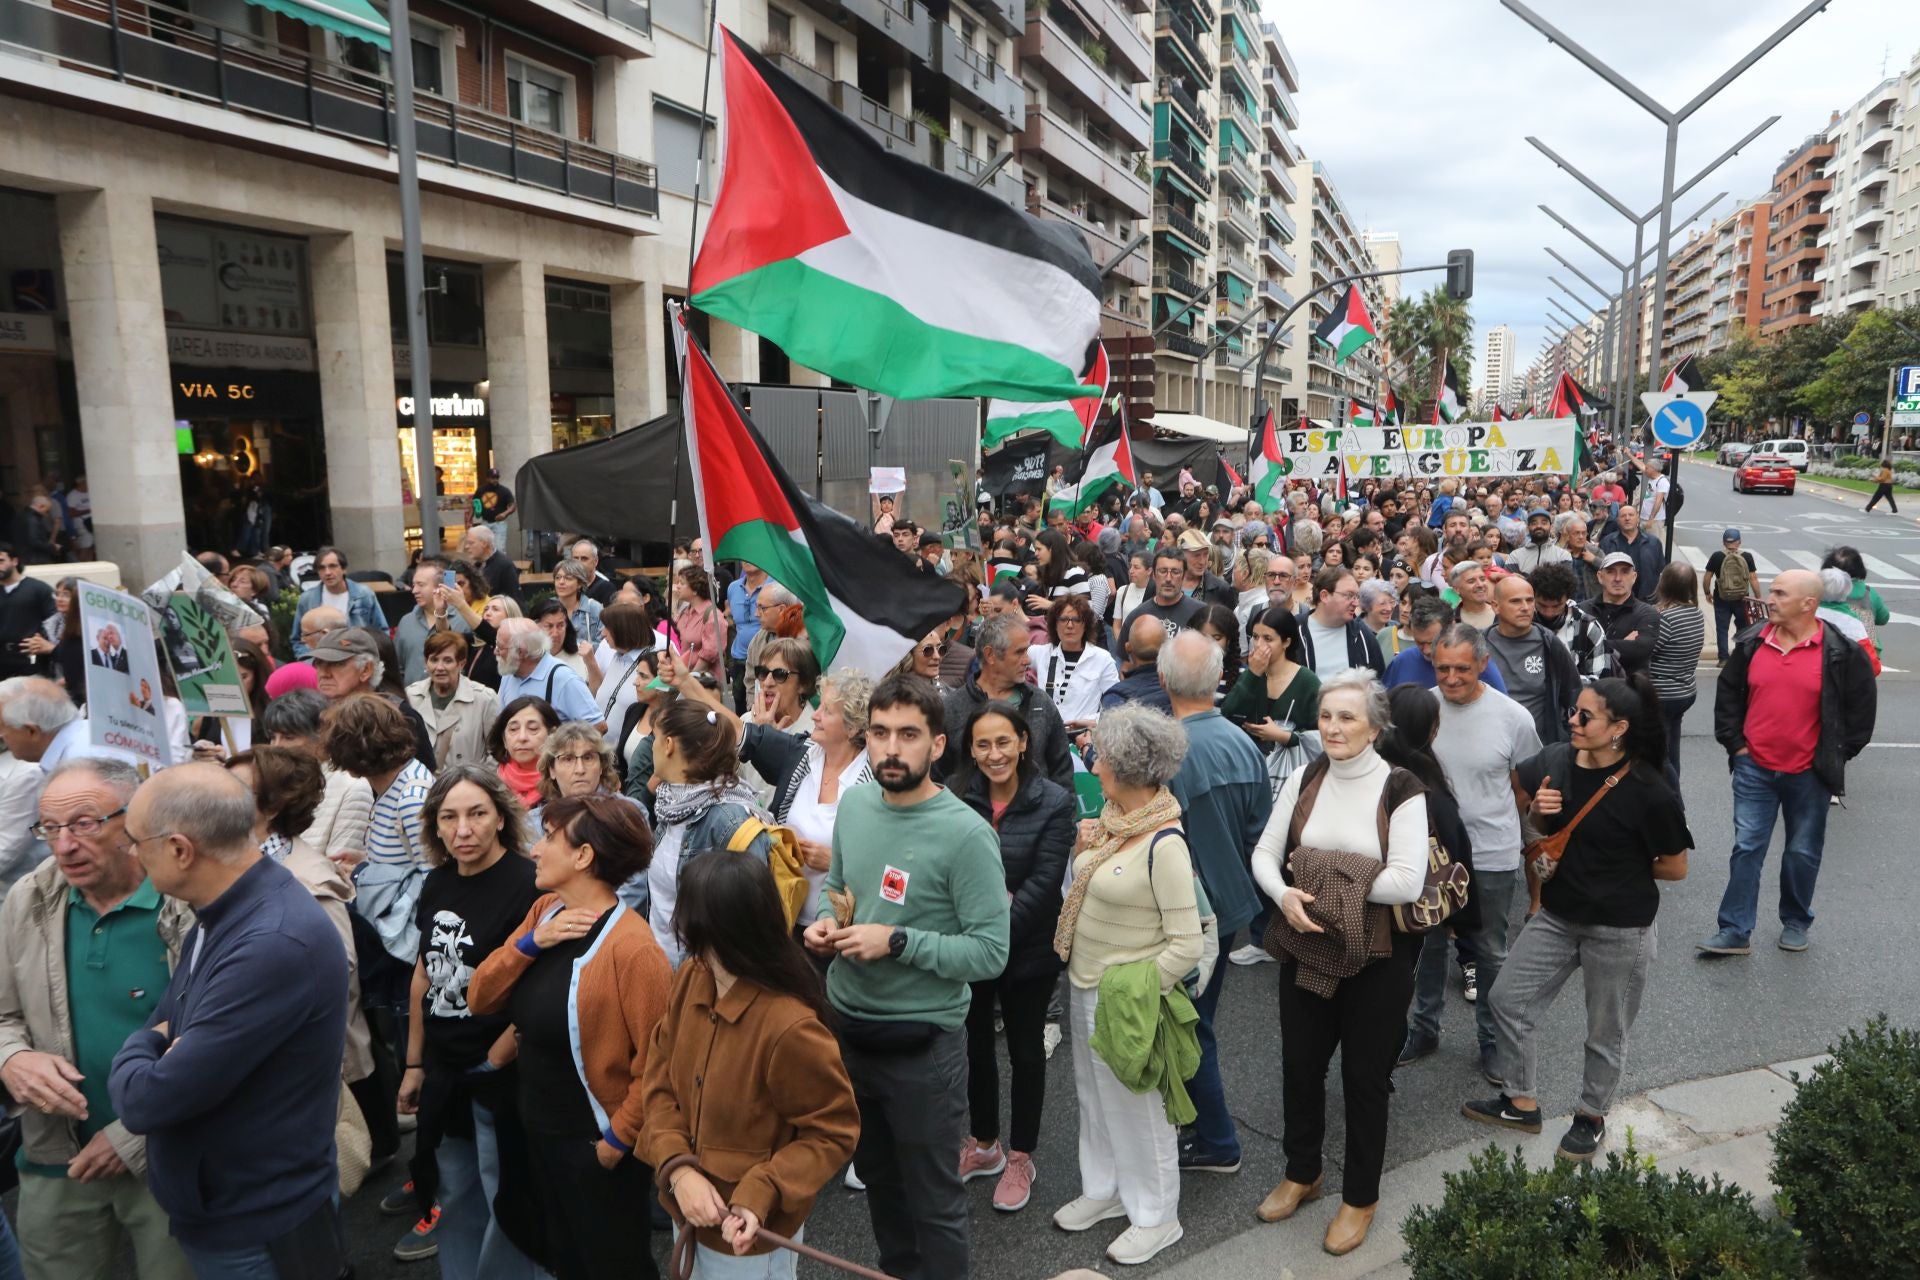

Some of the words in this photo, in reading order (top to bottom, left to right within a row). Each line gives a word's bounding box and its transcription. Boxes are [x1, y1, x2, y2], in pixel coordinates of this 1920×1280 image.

[180, 382, 217, 398] VIA
[1289, 430, 1361, 452] ESTA
[1383, 425, 1506, 449] EUROPA
[1280, 455, 1311, 476] OS
[85, 591, 148, 626] GENOCIDIO
[104, 731, 160, 760] CÓMPLICE
